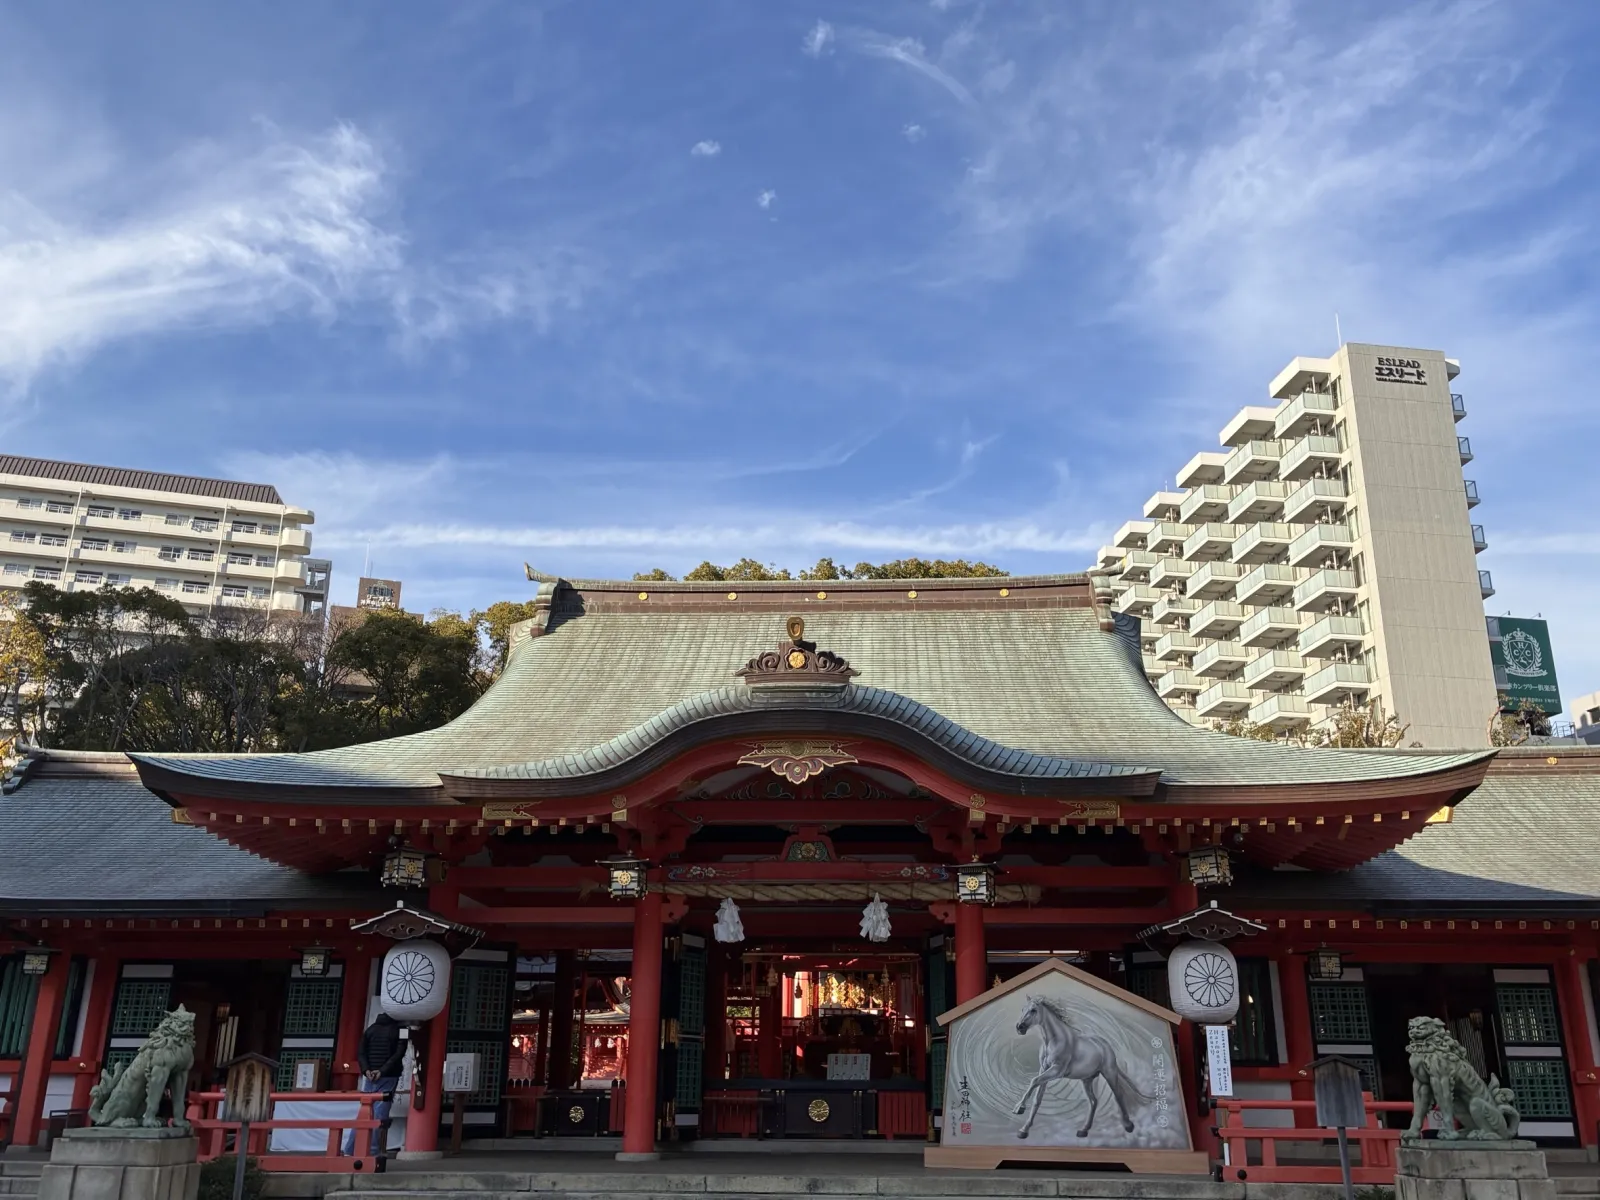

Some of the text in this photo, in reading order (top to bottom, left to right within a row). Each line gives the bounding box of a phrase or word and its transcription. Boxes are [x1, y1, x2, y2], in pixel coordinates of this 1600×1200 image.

[1377, 357, 1421, 368] ESLEAD
[1375, 366, 1426, 380] エスリード
[957, 1075, 972, 1122] 生田神社
